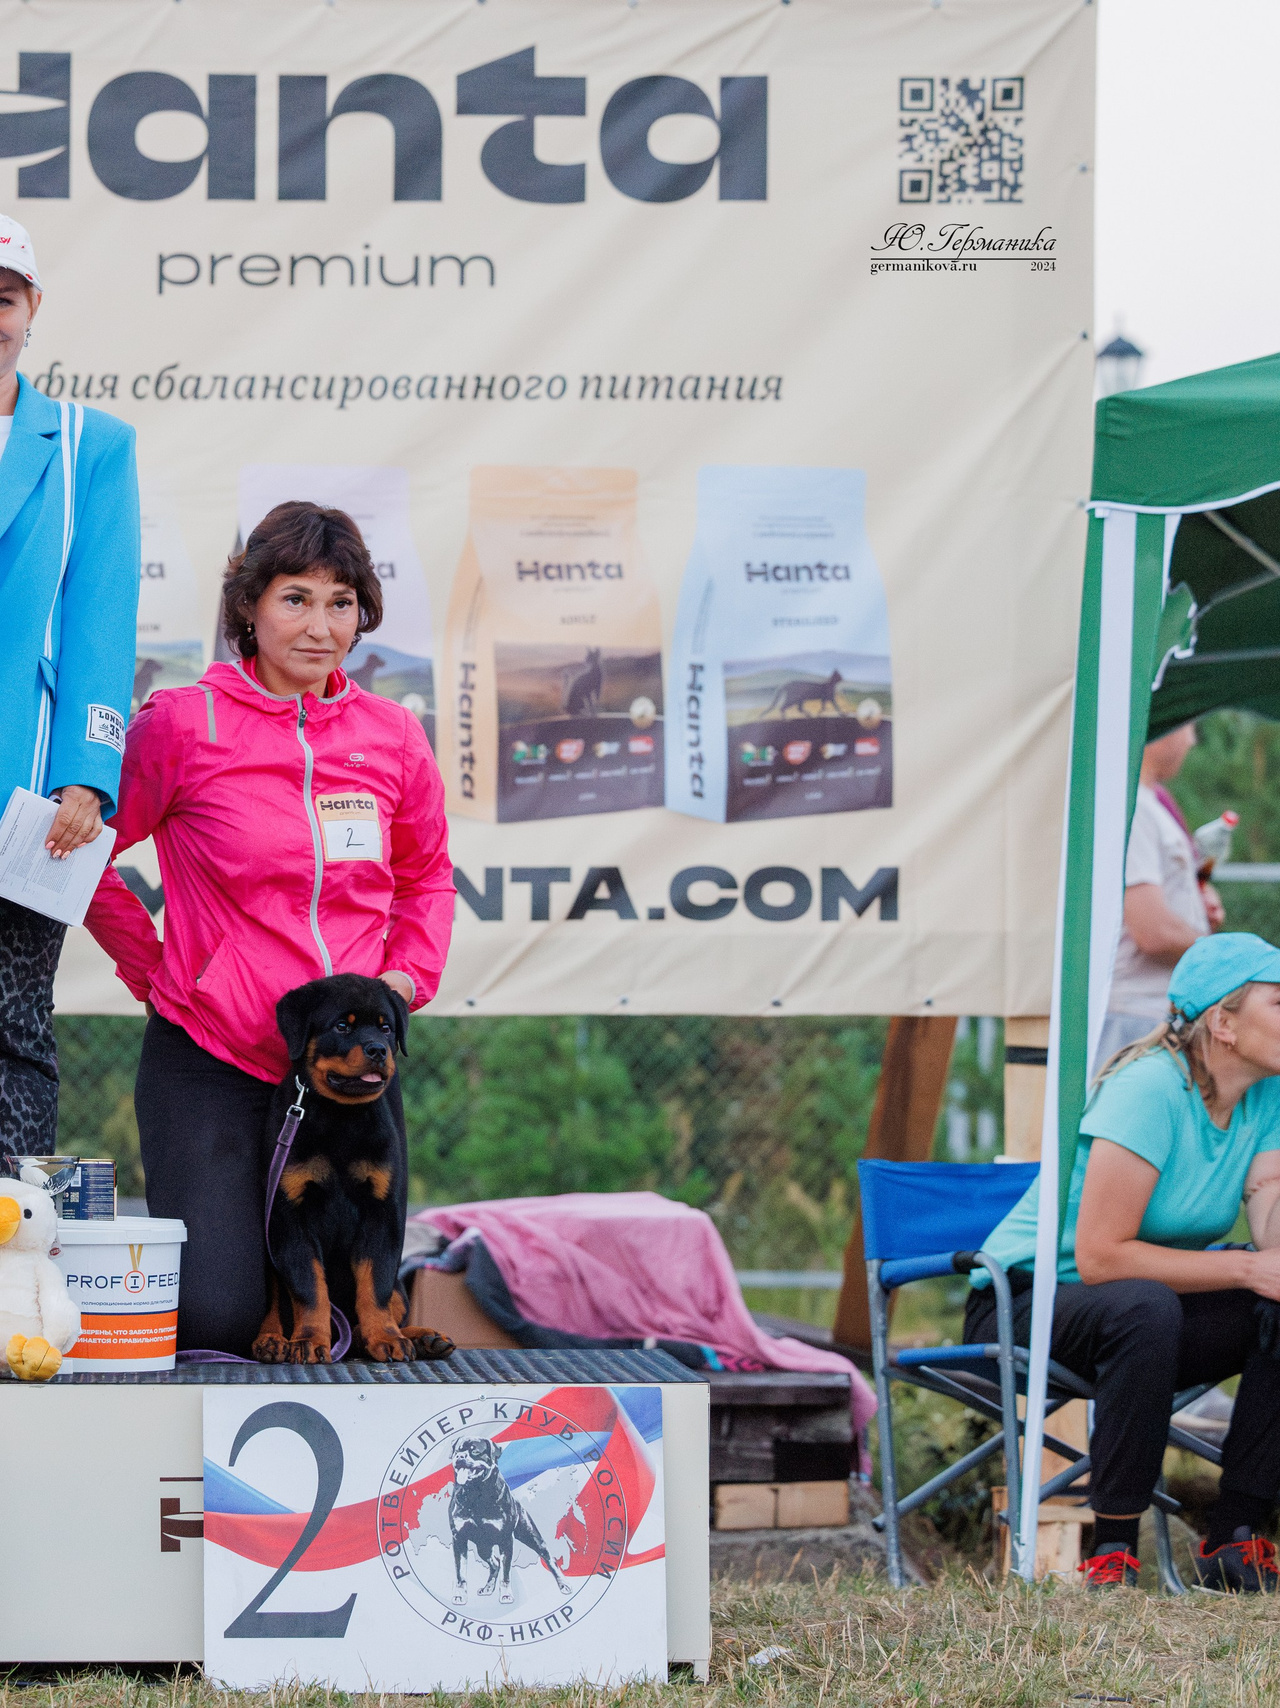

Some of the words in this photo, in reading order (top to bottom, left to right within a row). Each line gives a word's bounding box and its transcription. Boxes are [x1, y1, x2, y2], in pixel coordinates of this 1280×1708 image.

[158, 244, 497, 295] premium
[131, 362, 568, 411] сбалансированного
[580, 373, 784, 401] питания
[516, 560, 624, 581] Hanta
[745, 561, 851, 582] Hanta
[459, 662, 476, 800] Hanta
[687, 663, 704, 799] Hanta
[320, 799, 374, 810] Hanta
[346, 828, 365, 848] 2
[452, 865, 899, 921] NTA.COM
[381, 1406, 475, 1581] РОТВЕЙЛЕР
[493, 1402, 577, 1441] КЛУБ
[583, 1447, 623, 1581] РОССИИ
[223, 1401, 358, 1639] 2
[440, 1605, 575, 1643] РКФ-НКПР
